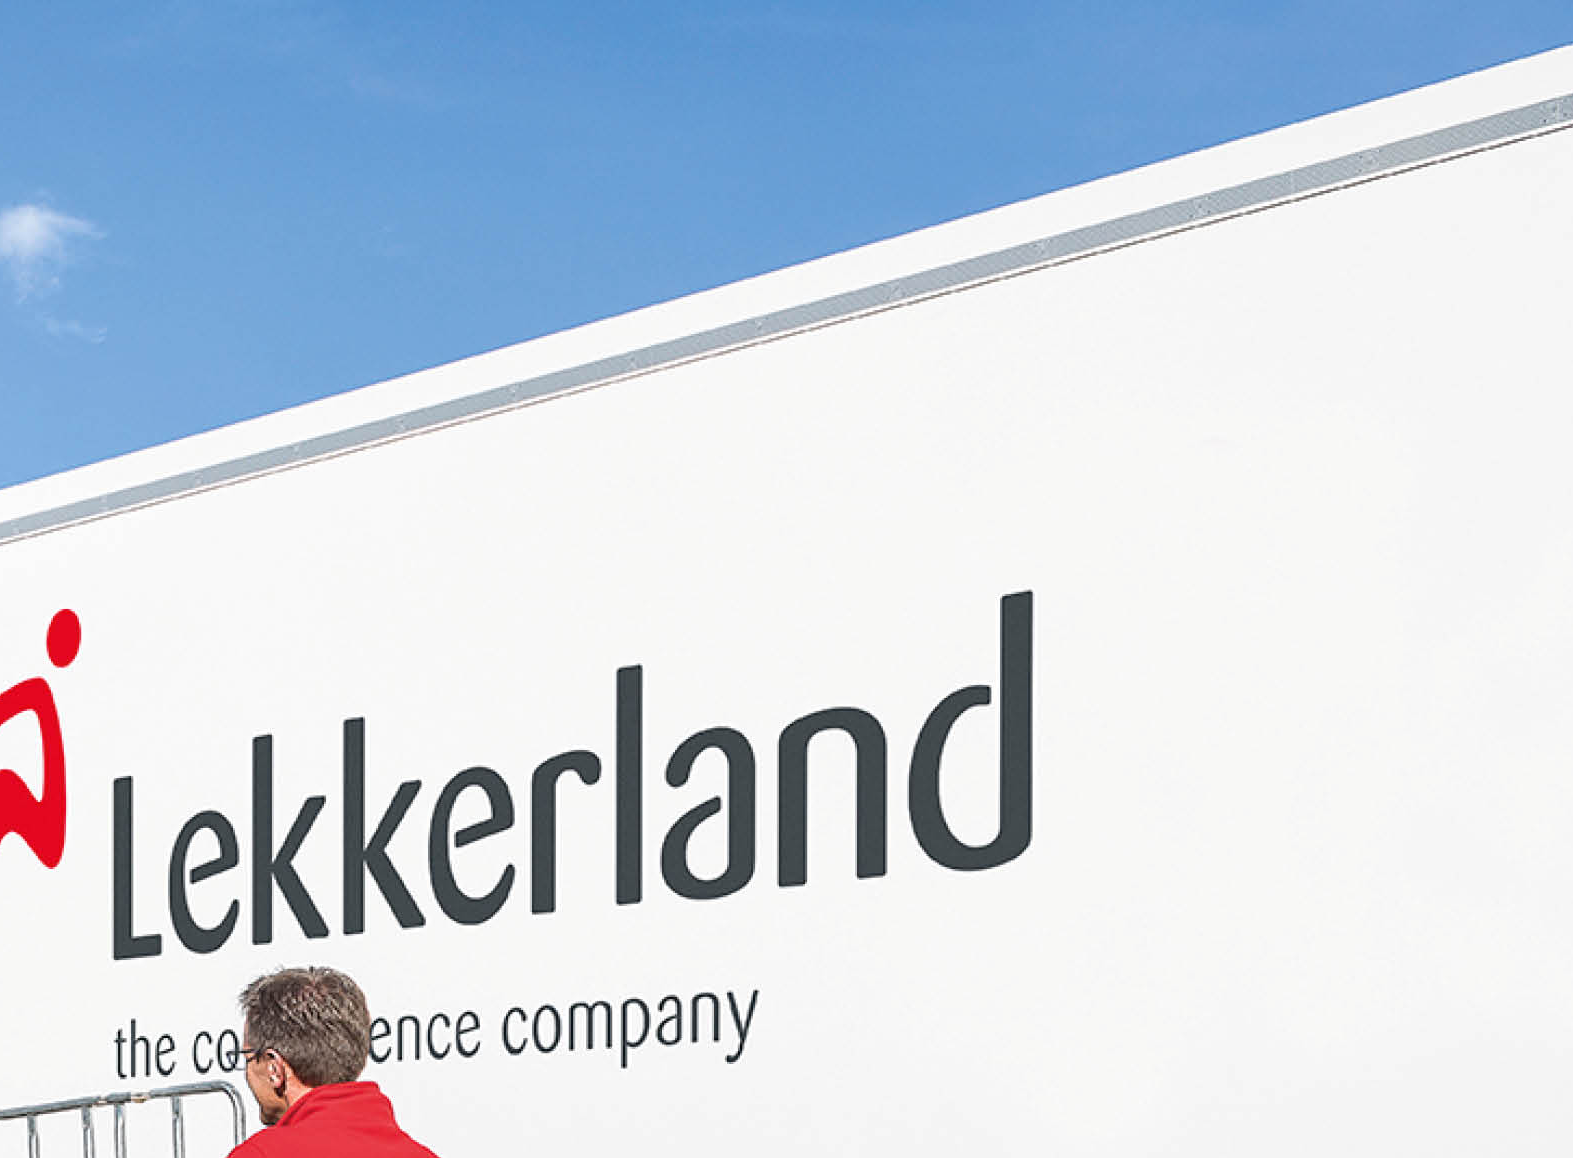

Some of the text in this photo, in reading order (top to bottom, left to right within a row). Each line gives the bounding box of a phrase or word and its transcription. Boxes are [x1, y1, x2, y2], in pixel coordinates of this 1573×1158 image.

[113, 590, 1034, 961] Lekkerland
[114, 989, 759, 1078] the coence company
